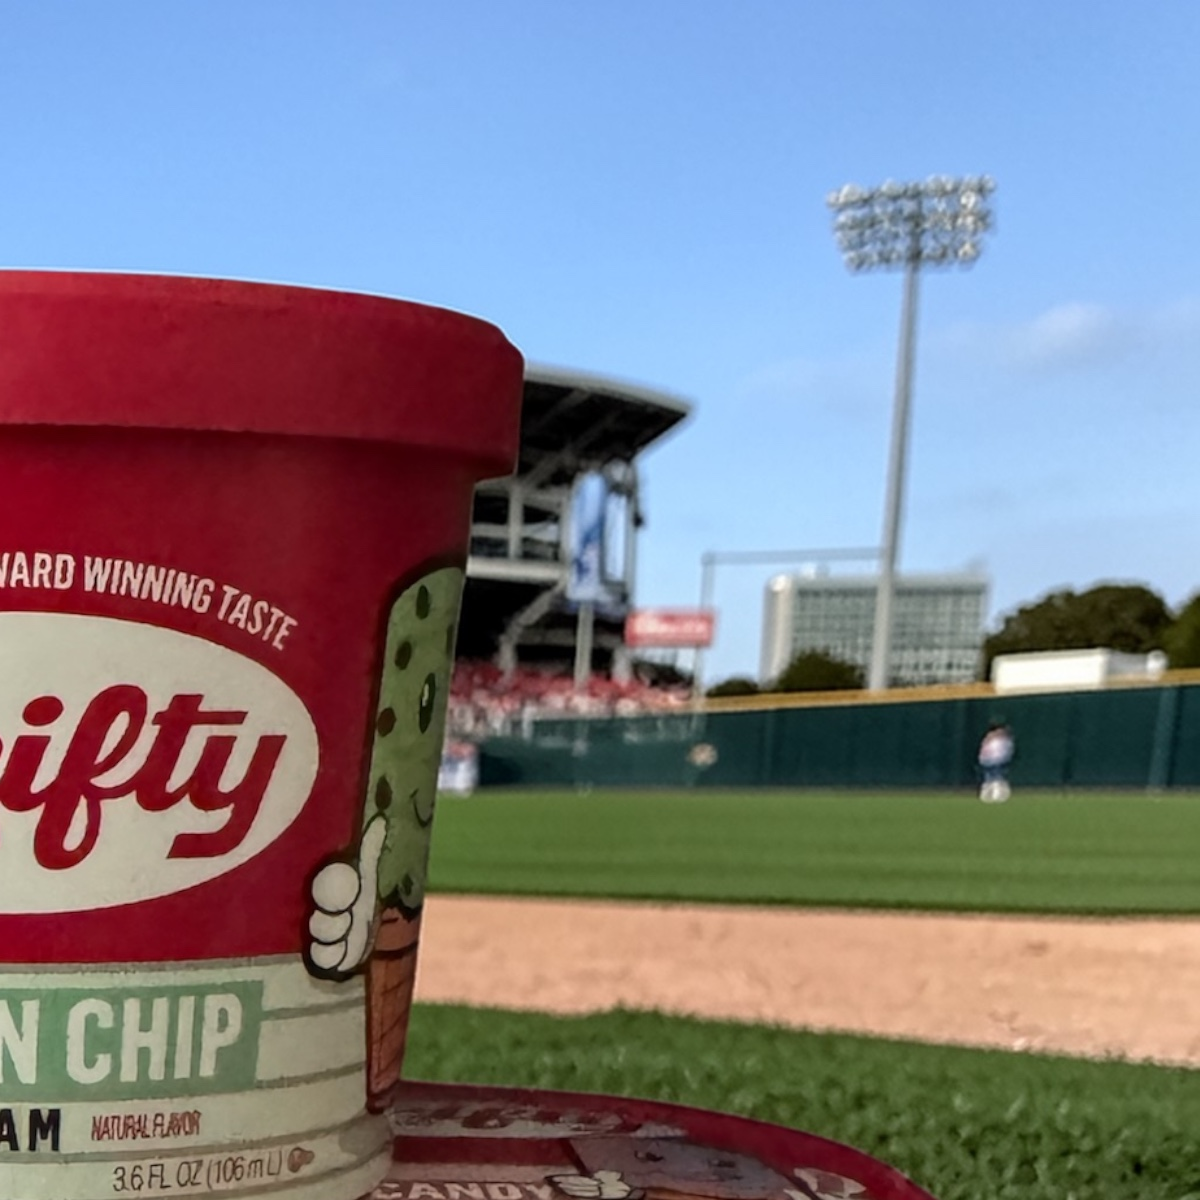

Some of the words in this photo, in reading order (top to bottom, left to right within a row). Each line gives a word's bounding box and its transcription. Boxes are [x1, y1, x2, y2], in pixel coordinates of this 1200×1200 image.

[85, 555, 214, 614] WINNING
[216, 584, 299, 650] TASTE
[65, 992, 243, 1083] CHIP
[91, 1114, 150, 1140] NATURAL
[153, 1110, 201, 1138] FLAVOR
[177, 1160, 203, 1187] OZ
[207, 1156, 244, 1190] (106
